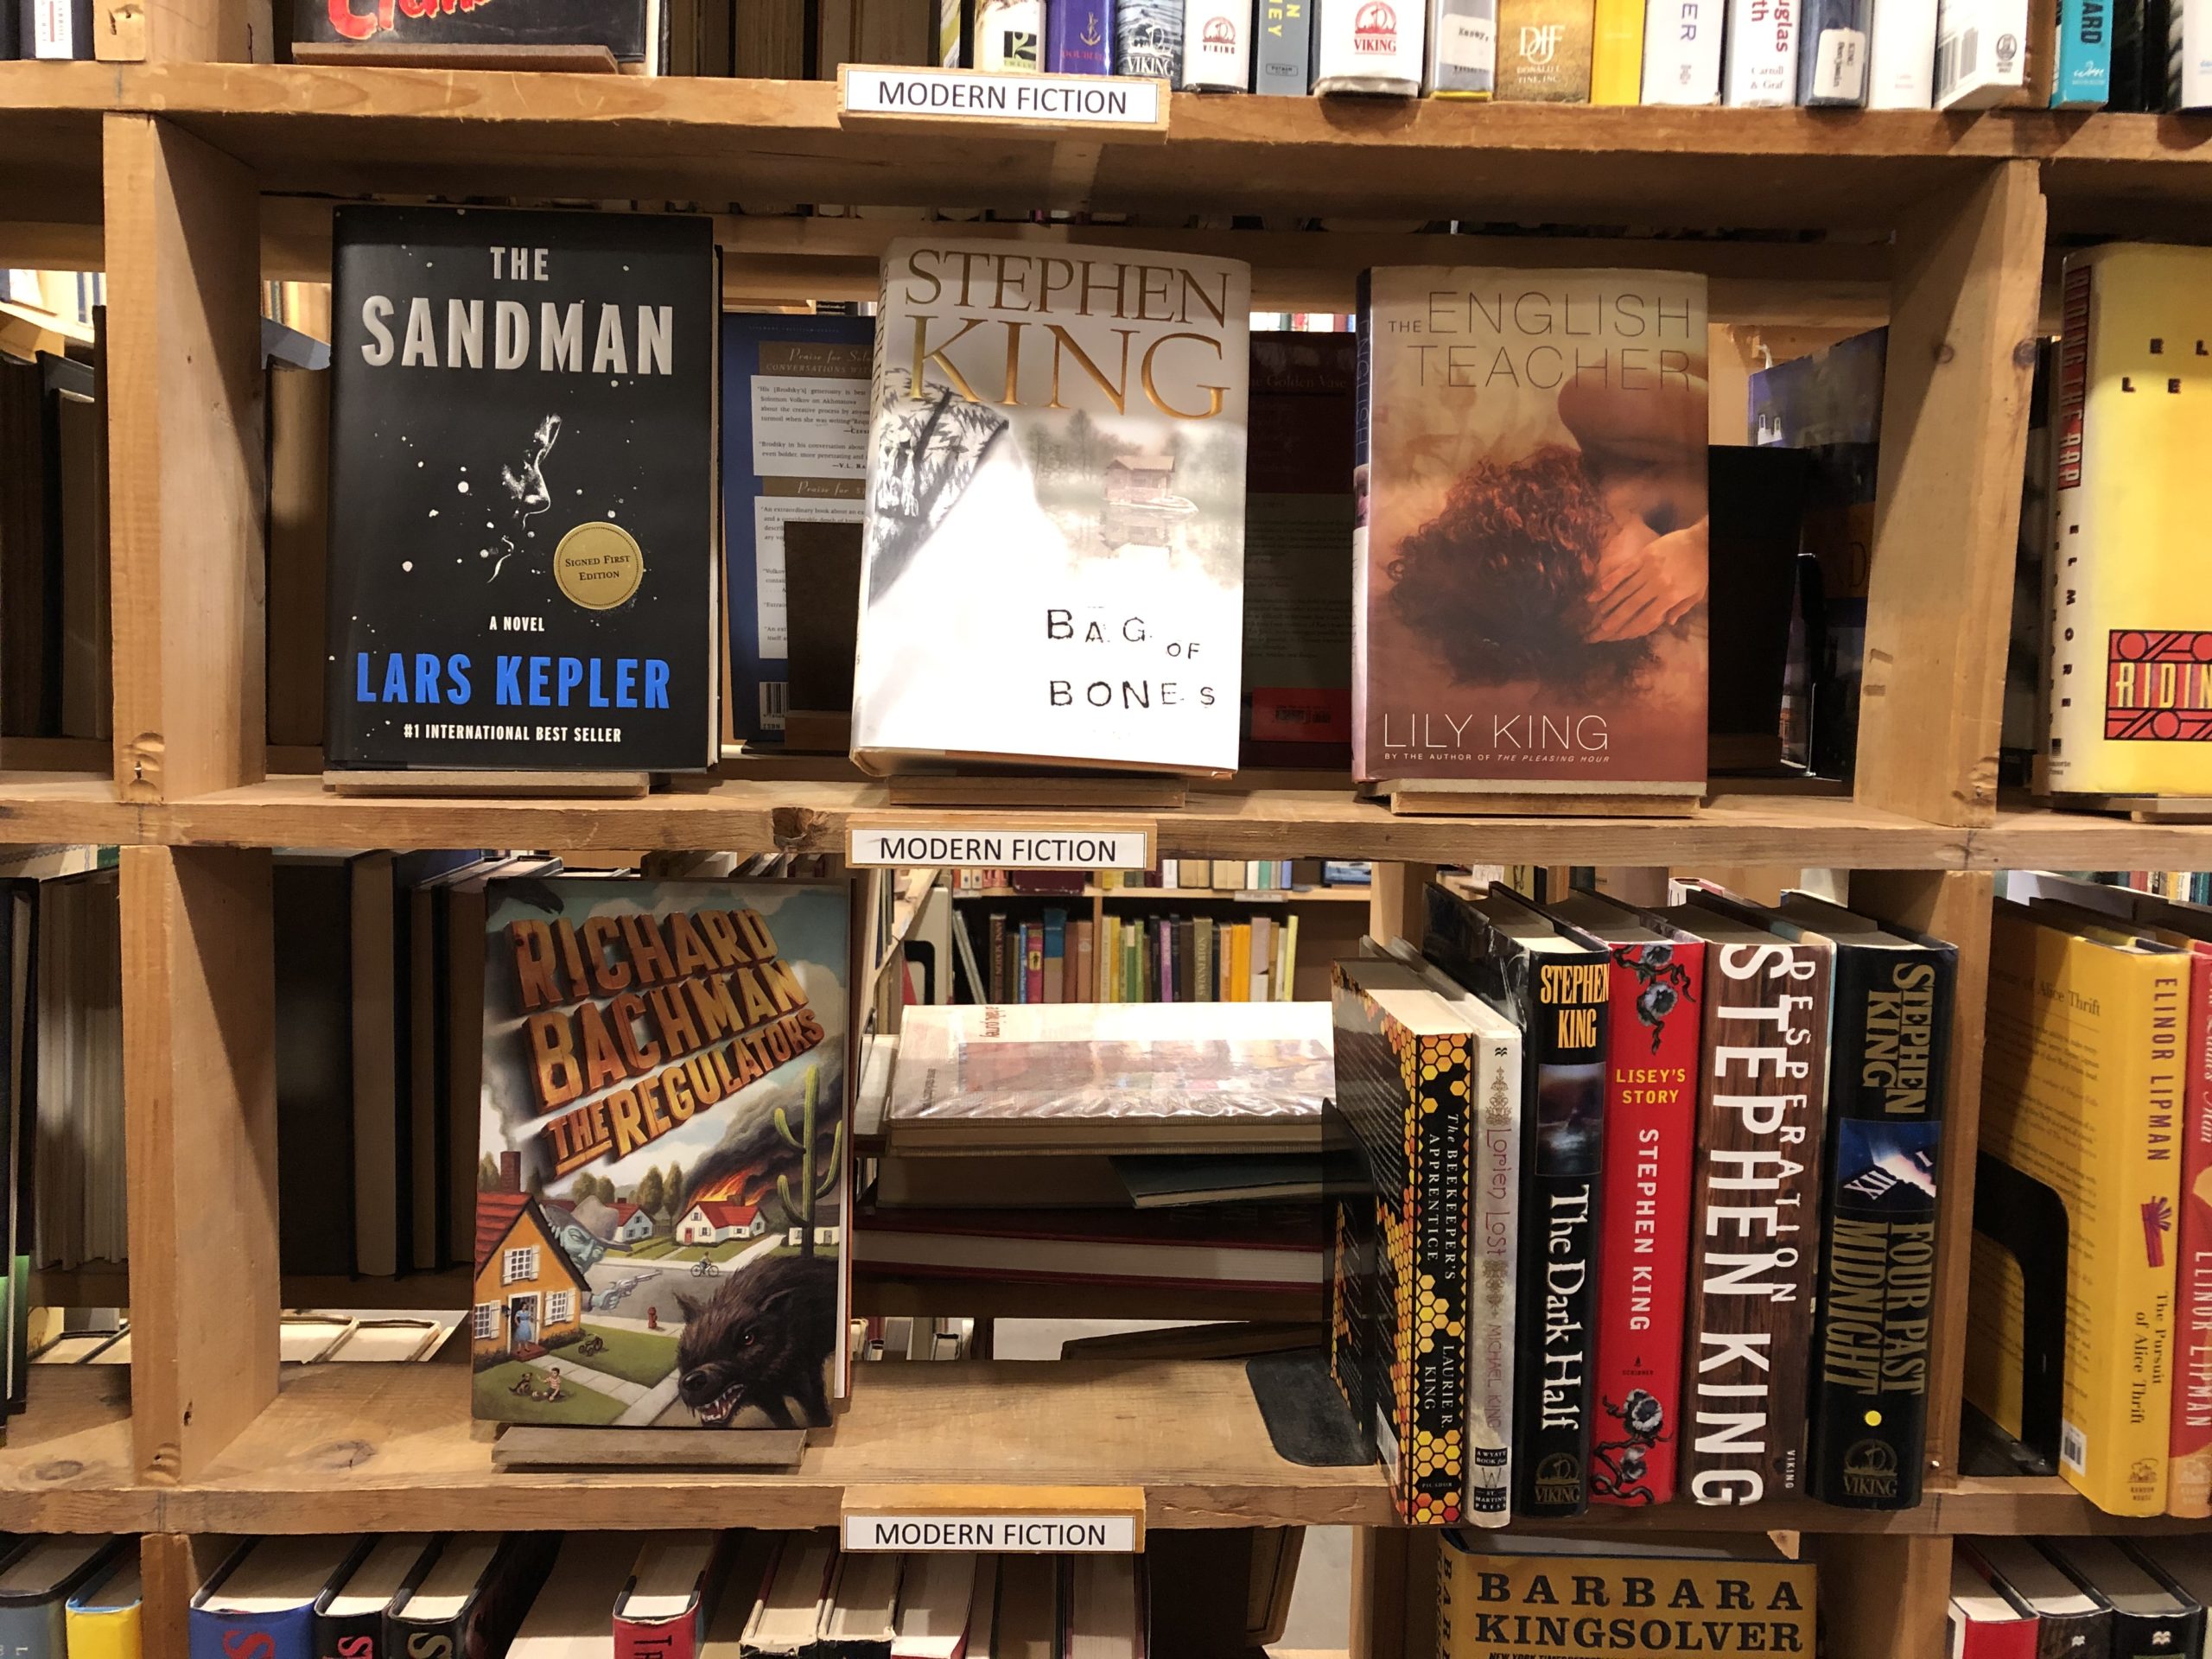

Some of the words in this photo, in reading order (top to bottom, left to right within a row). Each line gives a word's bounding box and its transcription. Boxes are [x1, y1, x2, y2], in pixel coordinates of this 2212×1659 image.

[1127, 56, 1174, 77] VIKING
[1203, 45, 1236, 54] VIKING
[1354, 39, 1396, 53] VIKING
[879, 81, 1006, 109] MODERN
[1018, 87, 1127, 114] FICTION
[490, 246, 550, 281] THE
[905, 248, 1231, 328] STEPHEN
[361, 295, 674, 375] SANDMAN
[1389, 321, 1422, 333] THE
[1428, 291, 1689, 338] ENGLISH
[905, 314, 1231, 420] KING
[1408, 345, 1690, 391] TEACHER
[489, 616, 498, 631] A
[504, 616, 545, 632] NOVEL
[1047, 608, 1146, 643] BAG
[1166, 642, 1200, 659] OF
[357, 652, 472, 705] LARS
[496, 655, 671, 709] KEPLER
[1049, 680, 1215, 709] BONES
[404, 724, 420, 738] #1
[425, 724, 531, 741] INTERNATIONAL
[536, 727, 568, 741] BEST
[574, 728, 622, 742] SELLER
[1384, 713, 1472, 748] LILY
[1494, 714, 1609, 751] KING
[1522, 754, 1575, 763] PLEASING
[880, 836, 1002, 860] MODERN
[1013, 839, 1116, 861] FICTION
[504, 909, 777, 1011] RICHARD
[1541, 963, 1609, 1004] STEPHEN
[2038, 981, 2065, 1004] Alice
[2068, 990, 2101, 1017] Thrift
[521, 960, 810, 1114] BACHMAN
[1557, 1008, 1598, 1048] KING
[1863, 989, 1901, 1088] KING
[1885, 962, 1936, 1114] STEPHEN
[2151, 977, 2177, 1060] ELINOR
[540, 1098, 613, 1163] THE
[602, 1008, 825, 1163] REGULATORS
[1616, 1068, 1686, 1084] LISEY'S
[1622, 1090, 1680, 1104] STORY
[1446, 1113, 1459, 1142] The
[1702, 943, 1794, 1295] STEPHEN
[1770, 961, 1815, 1302] DESPERATION
[2146, 1075, 2174, 1160] LIPMAN
[1427, 1133, 1440, 1261] APPRENTICE
[1634, 1128, 1660, 1254] STEPHEN
[1444, 1149, 1459, 1280] BEEKEEPER'S
[1484, 1211, 1511, 1256] Lost
[1549, 1184, 1590, 1255] The
[1886, 1219, 1936, 1311] FOUR
[1544, 1259, 1586, 1345] Dark
[1630, 1266, 1652, 1331] KING
[1823, 1215, 1889, 1395] MIDNIGHT
[2134, 1312, 2150, 1326] of
[2156, 1294, 2168, 1322] The
[1486, 1324, 1503, 1389] MICHAEL
[1881, 1317, 1929, 1395] PAST
[2133, 1335, 2148, 1372] Alice
[2152, 1328, 2167, 1384] Pursuit
[1424, 1366, 1437, 1410] KING
[1442, 1344, 1455, 1409] LAURIE
[1541, 1351, 1583, 1431] Half
[1440, 1414, 1453, 1428] R.
[1484, 1394, 1503, 1431] KING
[1692, 1332, 1771, 1506] KING
[2130, 1380, 2146, 1424] Thrift
[1785, 1449, 1796, 1489] VIKING
[1843, 1475, 1897, 1497] VIKING
[1535, 1485, 1580, 1504] VIKING
[875, 1523, 993, 1545] MODERN
[1004, 1524, 1105, 1546] FICTION
[1477, 1571, 1803, 1611] BARBARA
[1474, 1612, 1803, 1653] KINGSOLVER
